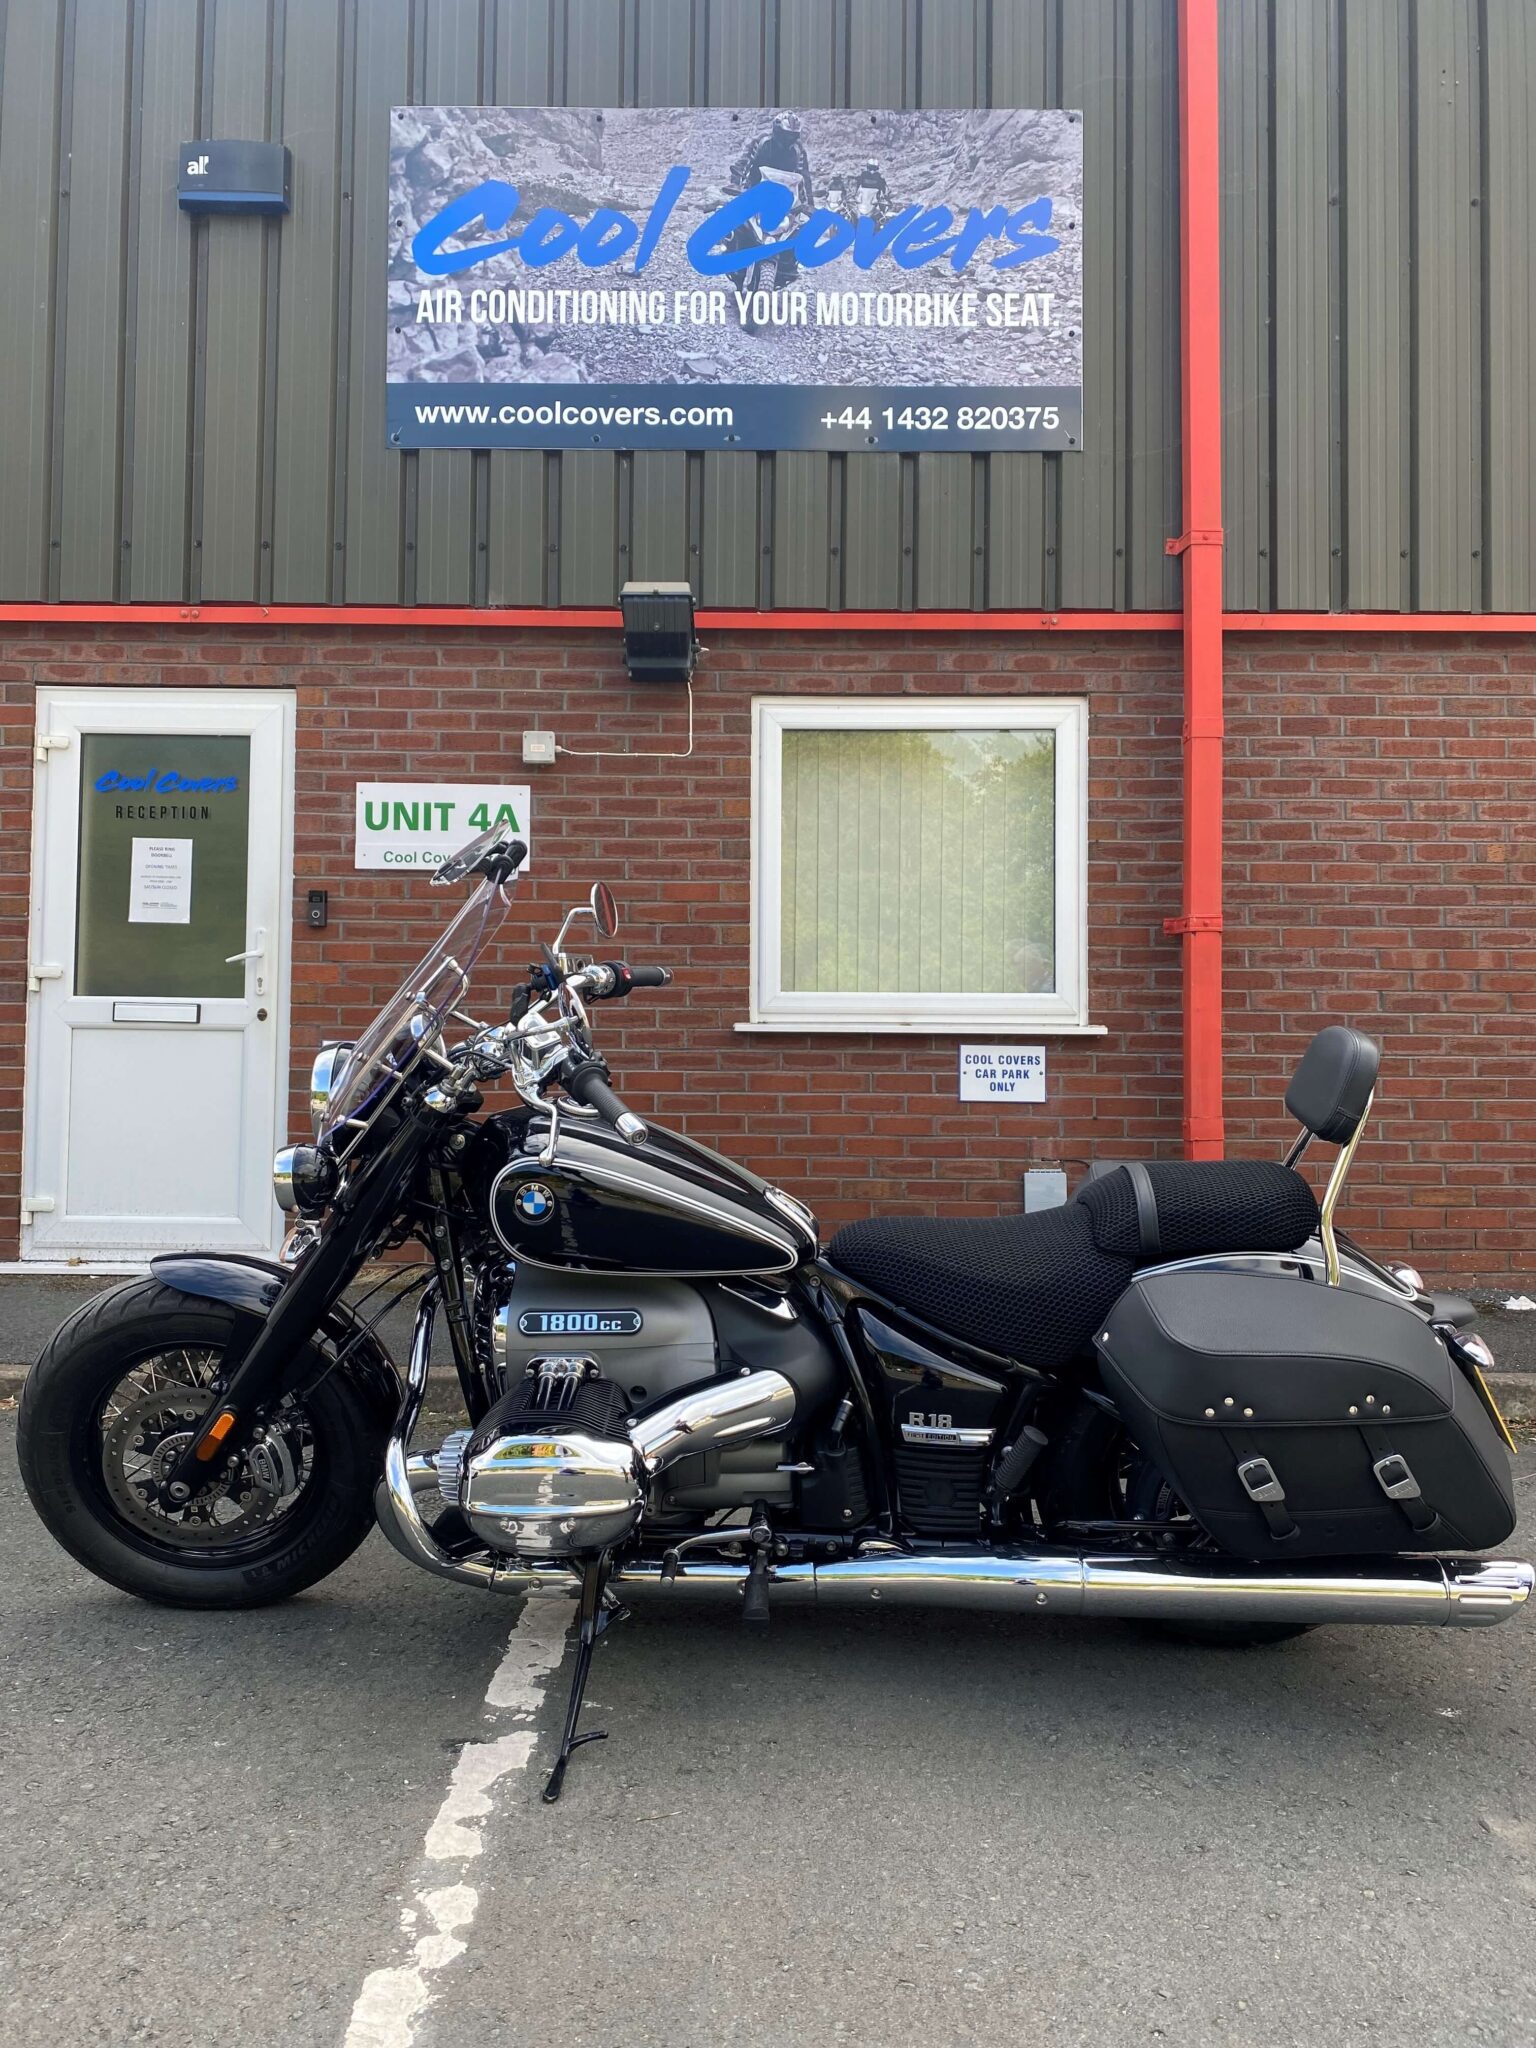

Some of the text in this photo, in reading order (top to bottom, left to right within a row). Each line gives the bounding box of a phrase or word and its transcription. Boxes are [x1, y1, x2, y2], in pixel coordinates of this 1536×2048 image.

[411, 166, 1062, 277] Cool Covers
[415, 289, 1061, 329] AIR CONDITIONING FOR YOUR MOTORBIKE SEAT.
[414, 402, 734, 428] www.coolcovers.com
[820, 405, 1061, 431] +44 1432 820375
[94, 768, 239, 794] Cool Covers
[115, 805, 210, 819] RECEPTION
[365, 801, 521, 833] UNIT 4A
[383, 851, 452, 864] Cool Cov
[965, 1054, 1041, 1066] COOL COVERS
[975, 1068, 1030, 1079] CAR PARK
[989, 1081, 1016, 1092] ONLY
[519, 1184, 551, 1199] BMW
[540, 1313, 622, 1331] 1800cc
[258, 1458, 271, 1479] BMW
